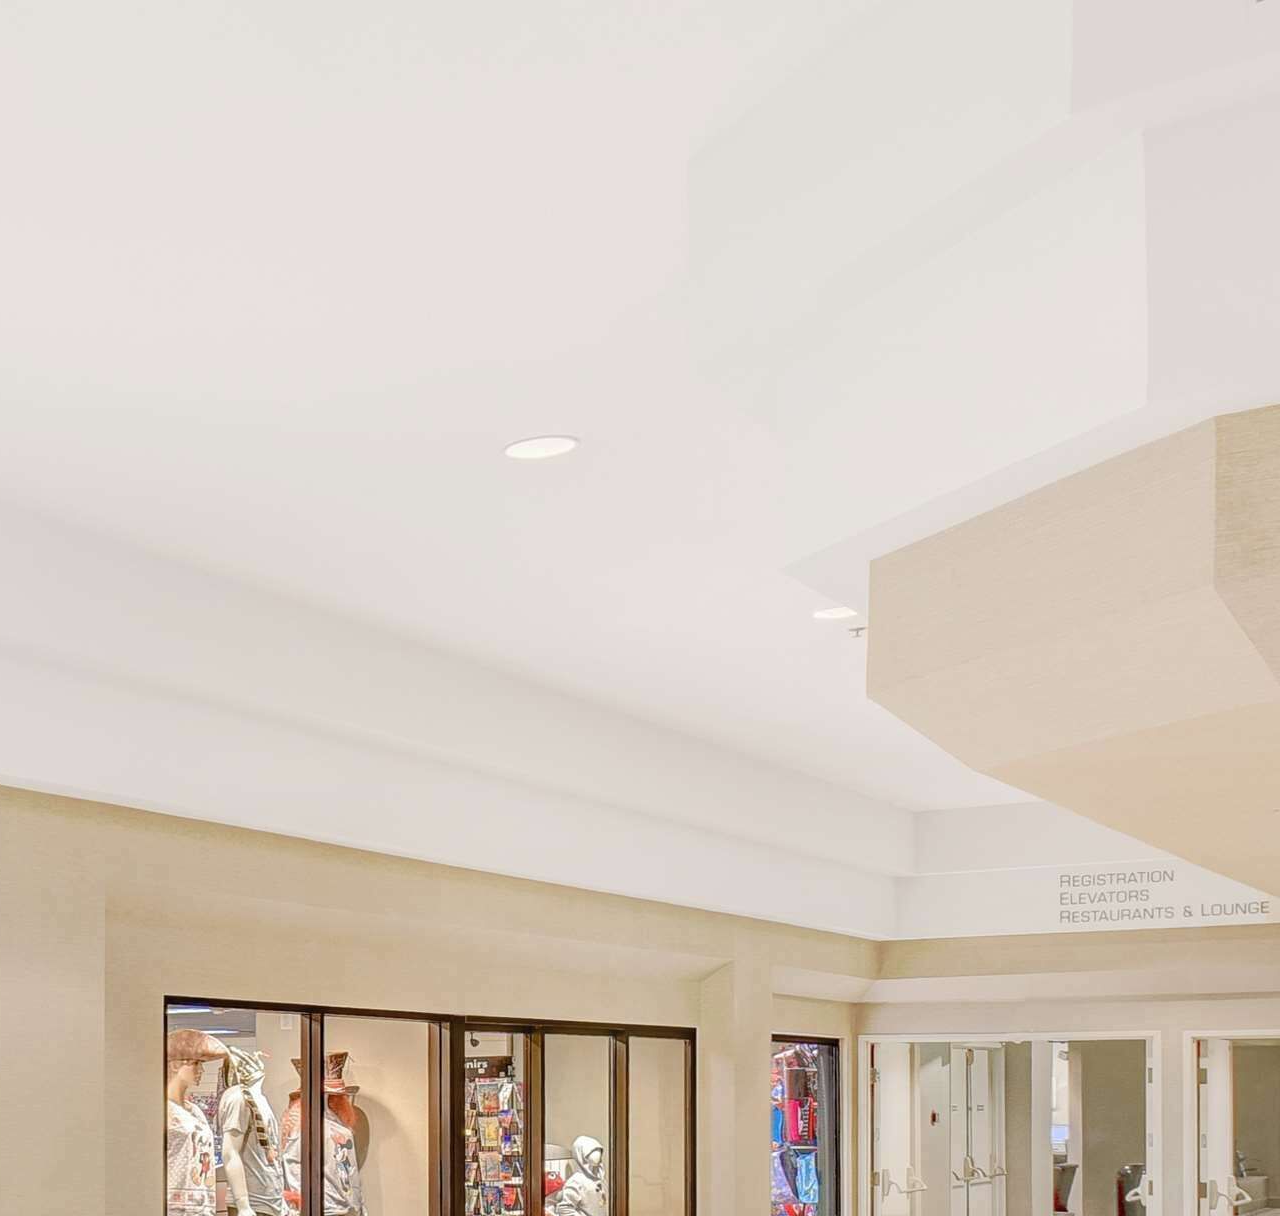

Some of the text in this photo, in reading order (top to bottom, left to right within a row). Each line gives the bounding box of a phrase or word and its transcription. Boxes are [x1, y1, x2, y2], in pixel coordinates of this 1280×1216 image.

[1059, 870, 1175, 888] REGISTRATION
[1059, 889, 1150, 906] ELEVATORS
[1059, 901, 1271, 924] RESTAURANTS & LOUNGE
[465, 1058, 489, 1069] nirs
